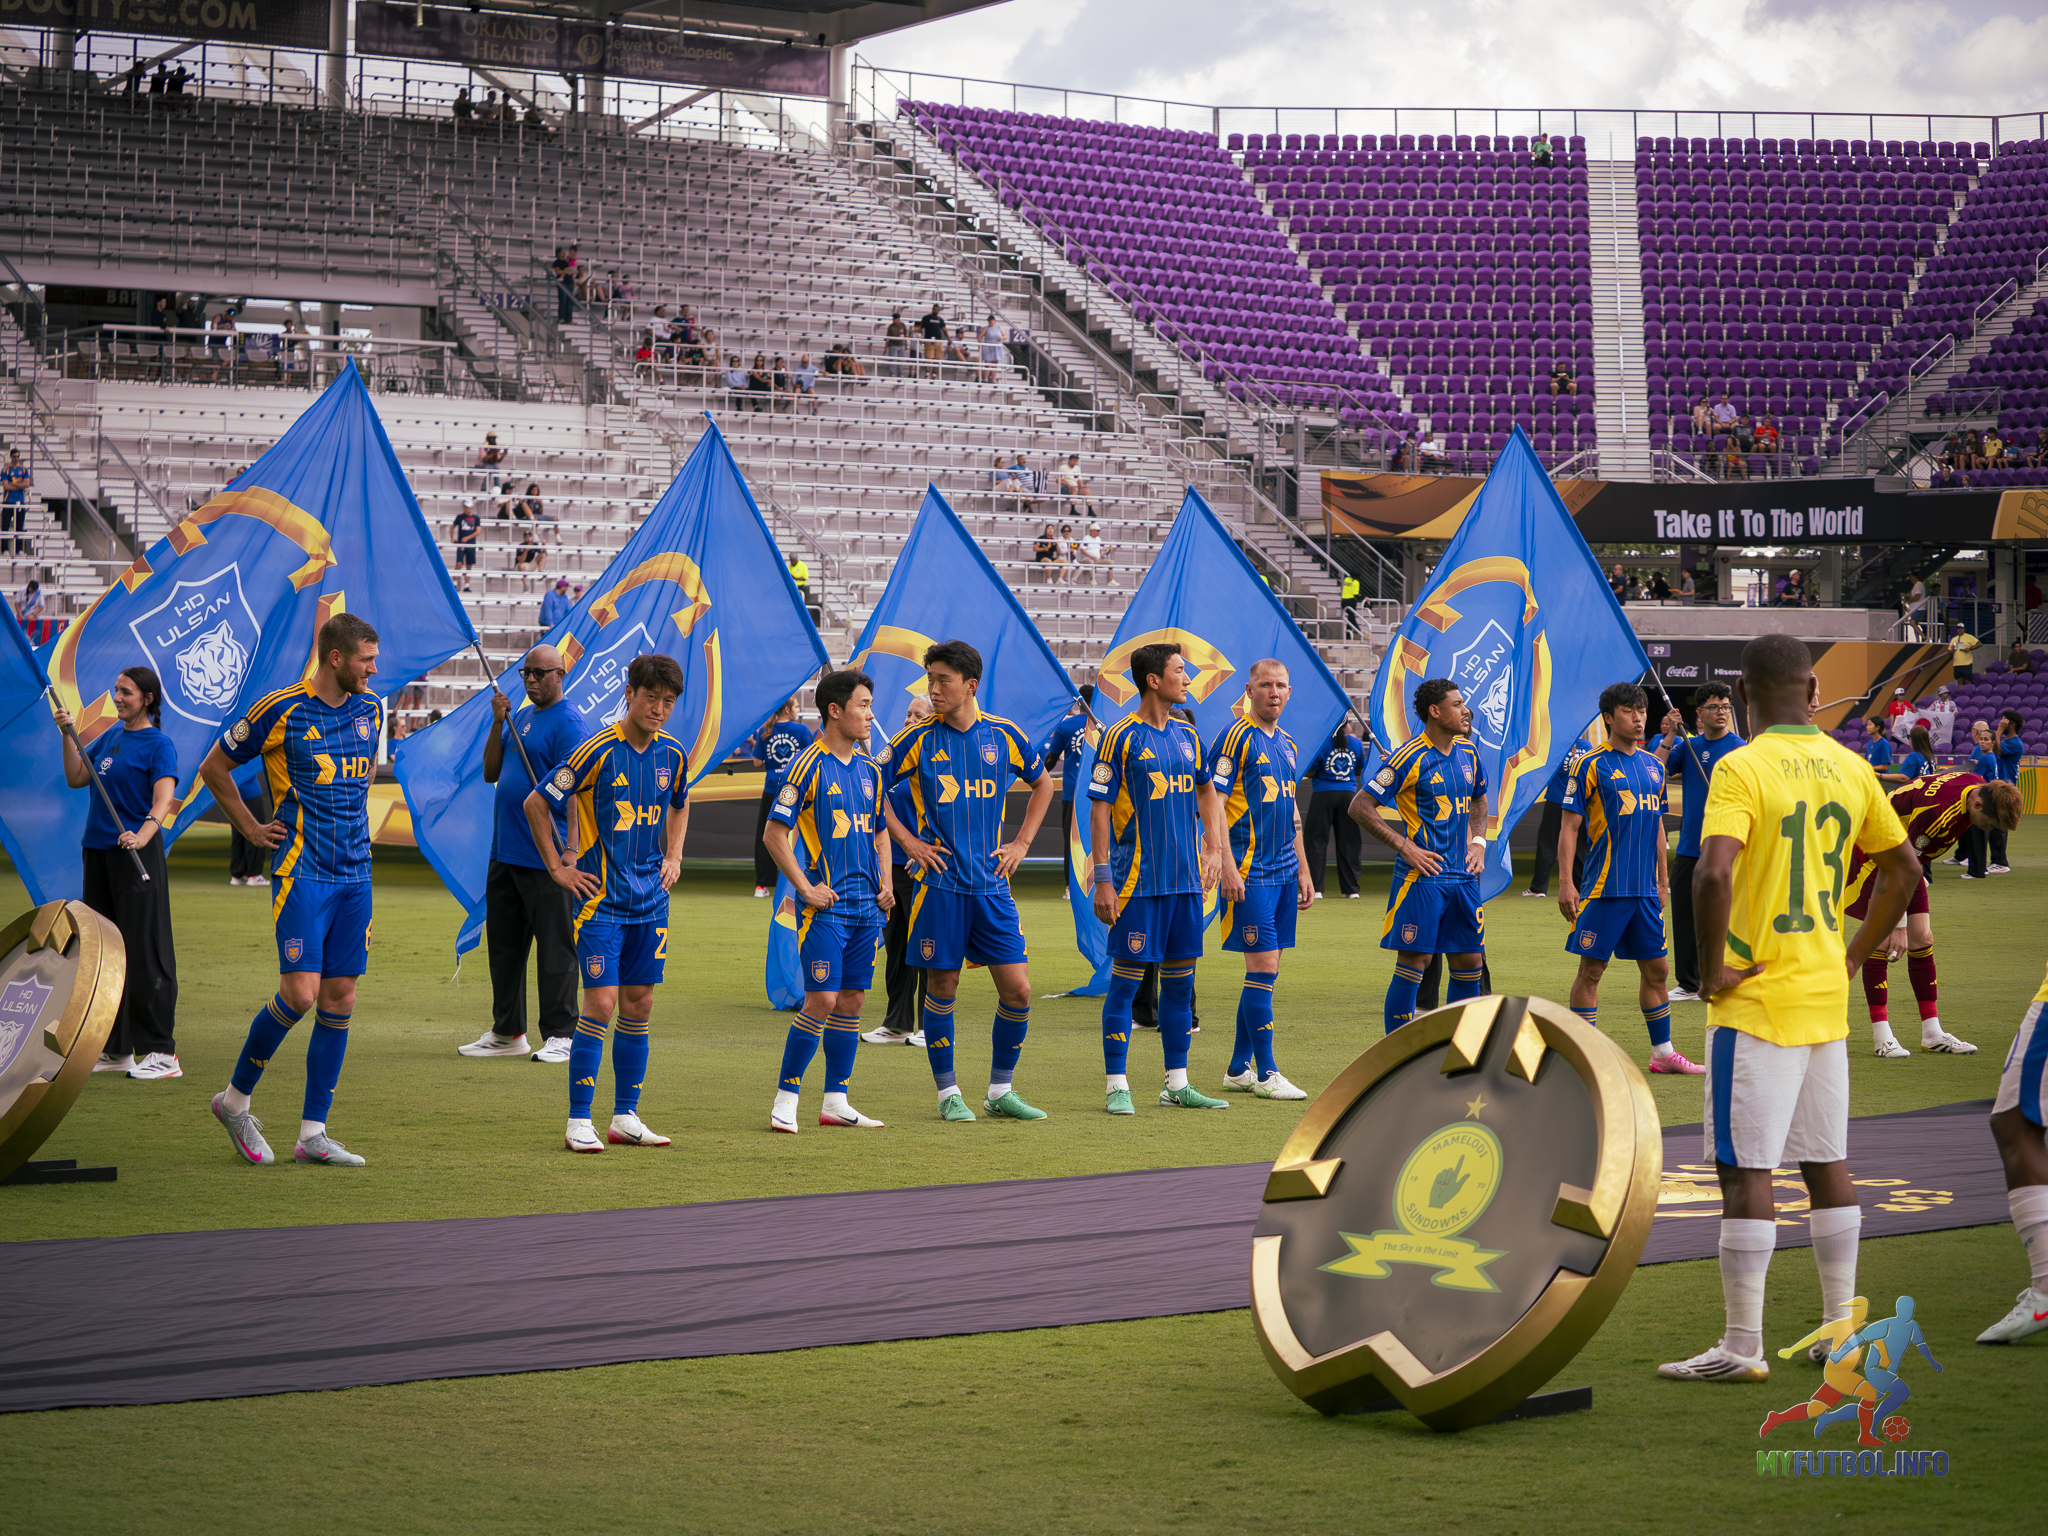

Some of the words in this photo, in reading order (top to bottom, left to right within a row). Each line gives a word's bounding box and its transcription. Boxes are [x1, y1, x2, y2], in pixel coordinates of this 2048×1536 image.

[461, 17, 558, 43] ORLANDO
[472, 40, 547, 65] HEALTH
[607, 36, 653, 52] Jewett
[606, 52, 664, 71] Institute
[1653, 509, 1712, 538] Take
[1718, 509, 1736, 538] It
[1740, 509, 1766, 537] To
[1770, 508, 1803, 537] The
[1808, 506, 1864, 536] World
[174, 593, 206, 617] HD
[156, 591, 231, 647] ULSAN
[1653, 646, 1665, 655] 29
[590, 658, 618, 684] HD
[1459, 654, 1481, 679] HD
[341, 756, 370, 779] HD
[1781, 758, 1842, 782] RAYNERS
[964, 779, 997, 798] HD
[1169, 774, 1194, 794] HD
[1638, 793, 1661, 812] HD
[636, 805, 662, 826] HD
[1772, 800, 1852, 933] 13
[1476, 906, 1485, 934] 9
[2, 1000, 39, 1014] ULSAN
[19, 990, 34, 1000] HD
[1432, 1135, 1489, 1159] MAMELODI
[1406, 1202, 1468, 1230] SUNDOWNS
[1383, 1243, 1398, 1251] The
[1399, 1243, 1414, 1253] Sky
[1415, 1245, 1423, 1253] is
[1424, 1246, 1437, 1254] the
[1438, 1248, 1459, 1259] Limit
